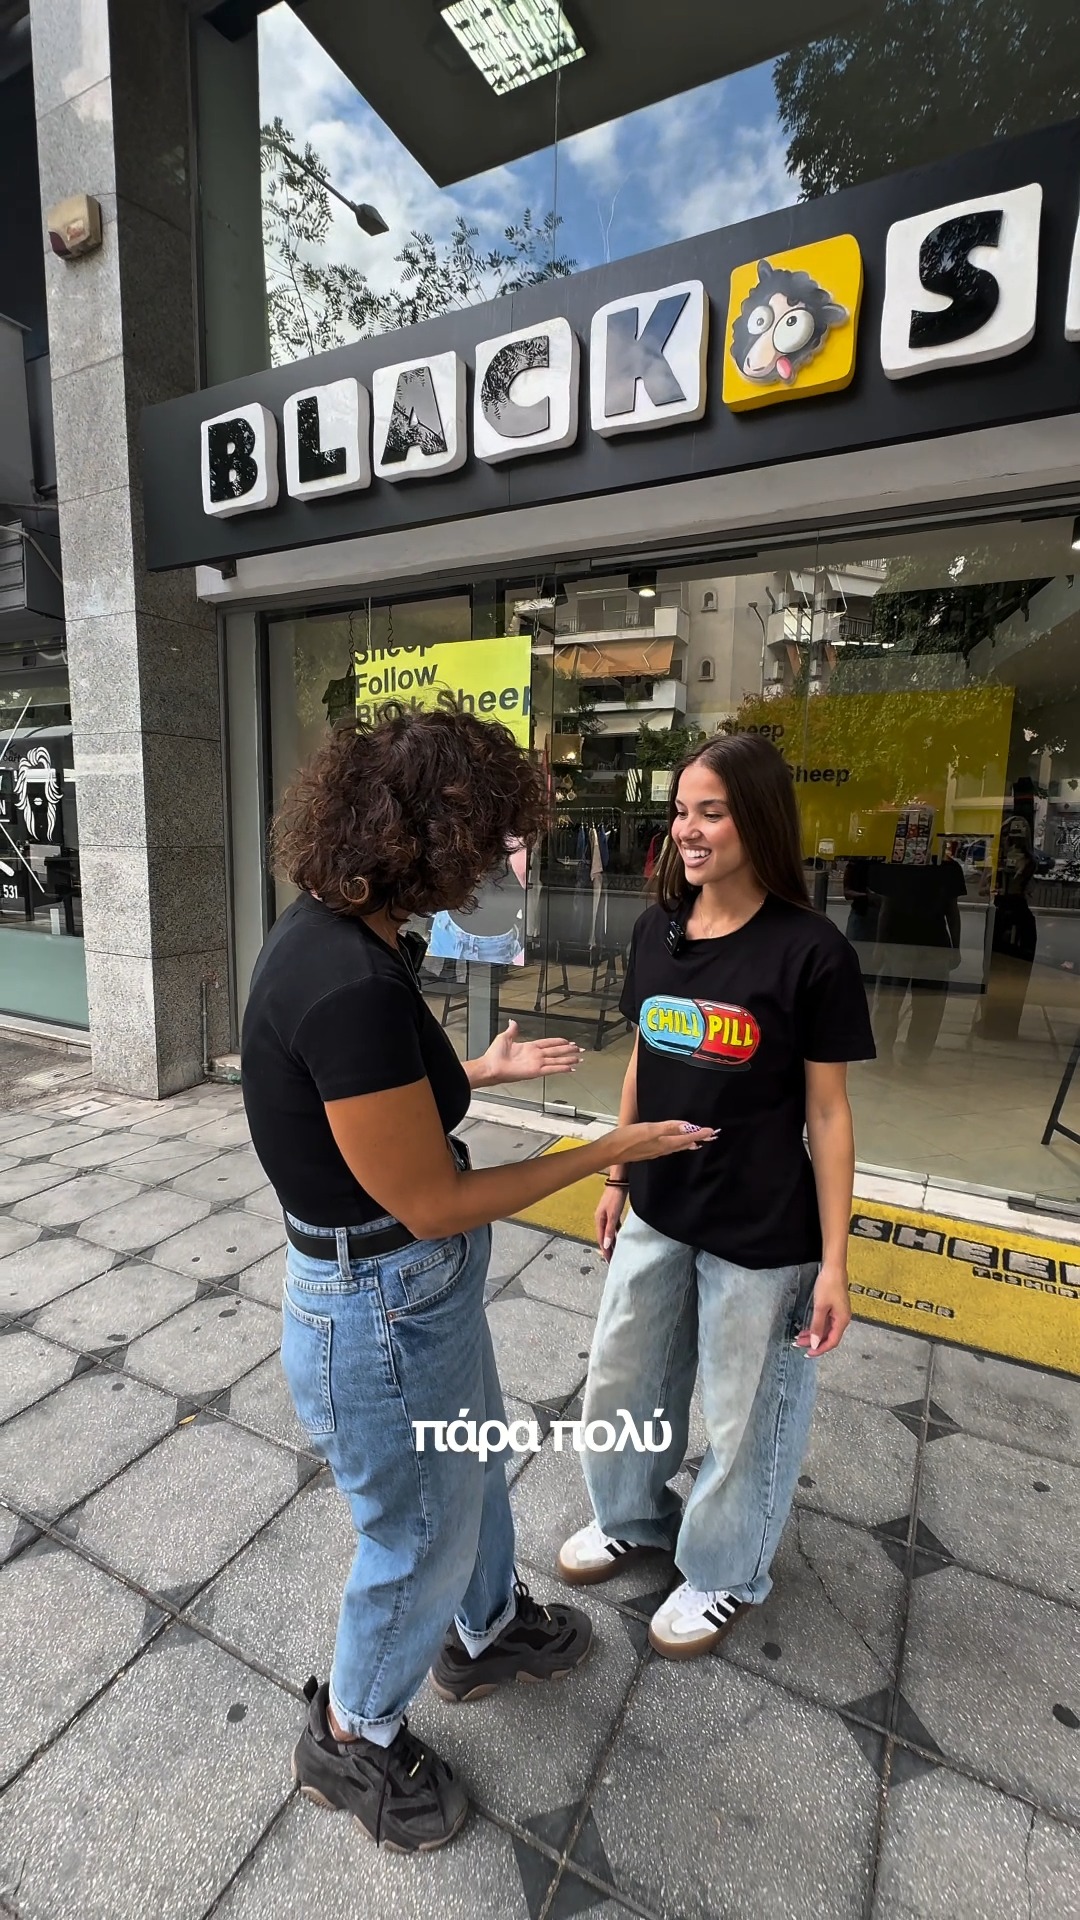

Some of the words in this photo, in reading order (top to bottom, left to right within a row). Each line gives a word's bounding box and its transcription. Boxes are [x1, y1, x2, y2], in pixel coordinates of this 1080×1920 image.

[206, 290, 692, 504] BLACK
[355, 664, 438, 698] Follow
[3, 884, 18, 899] 531
[646, 1006, 701, 1038] CHILL
[707, 1014, 754, 1047] PILL
[973, 1266, 1080, 1299] T-SHIR
